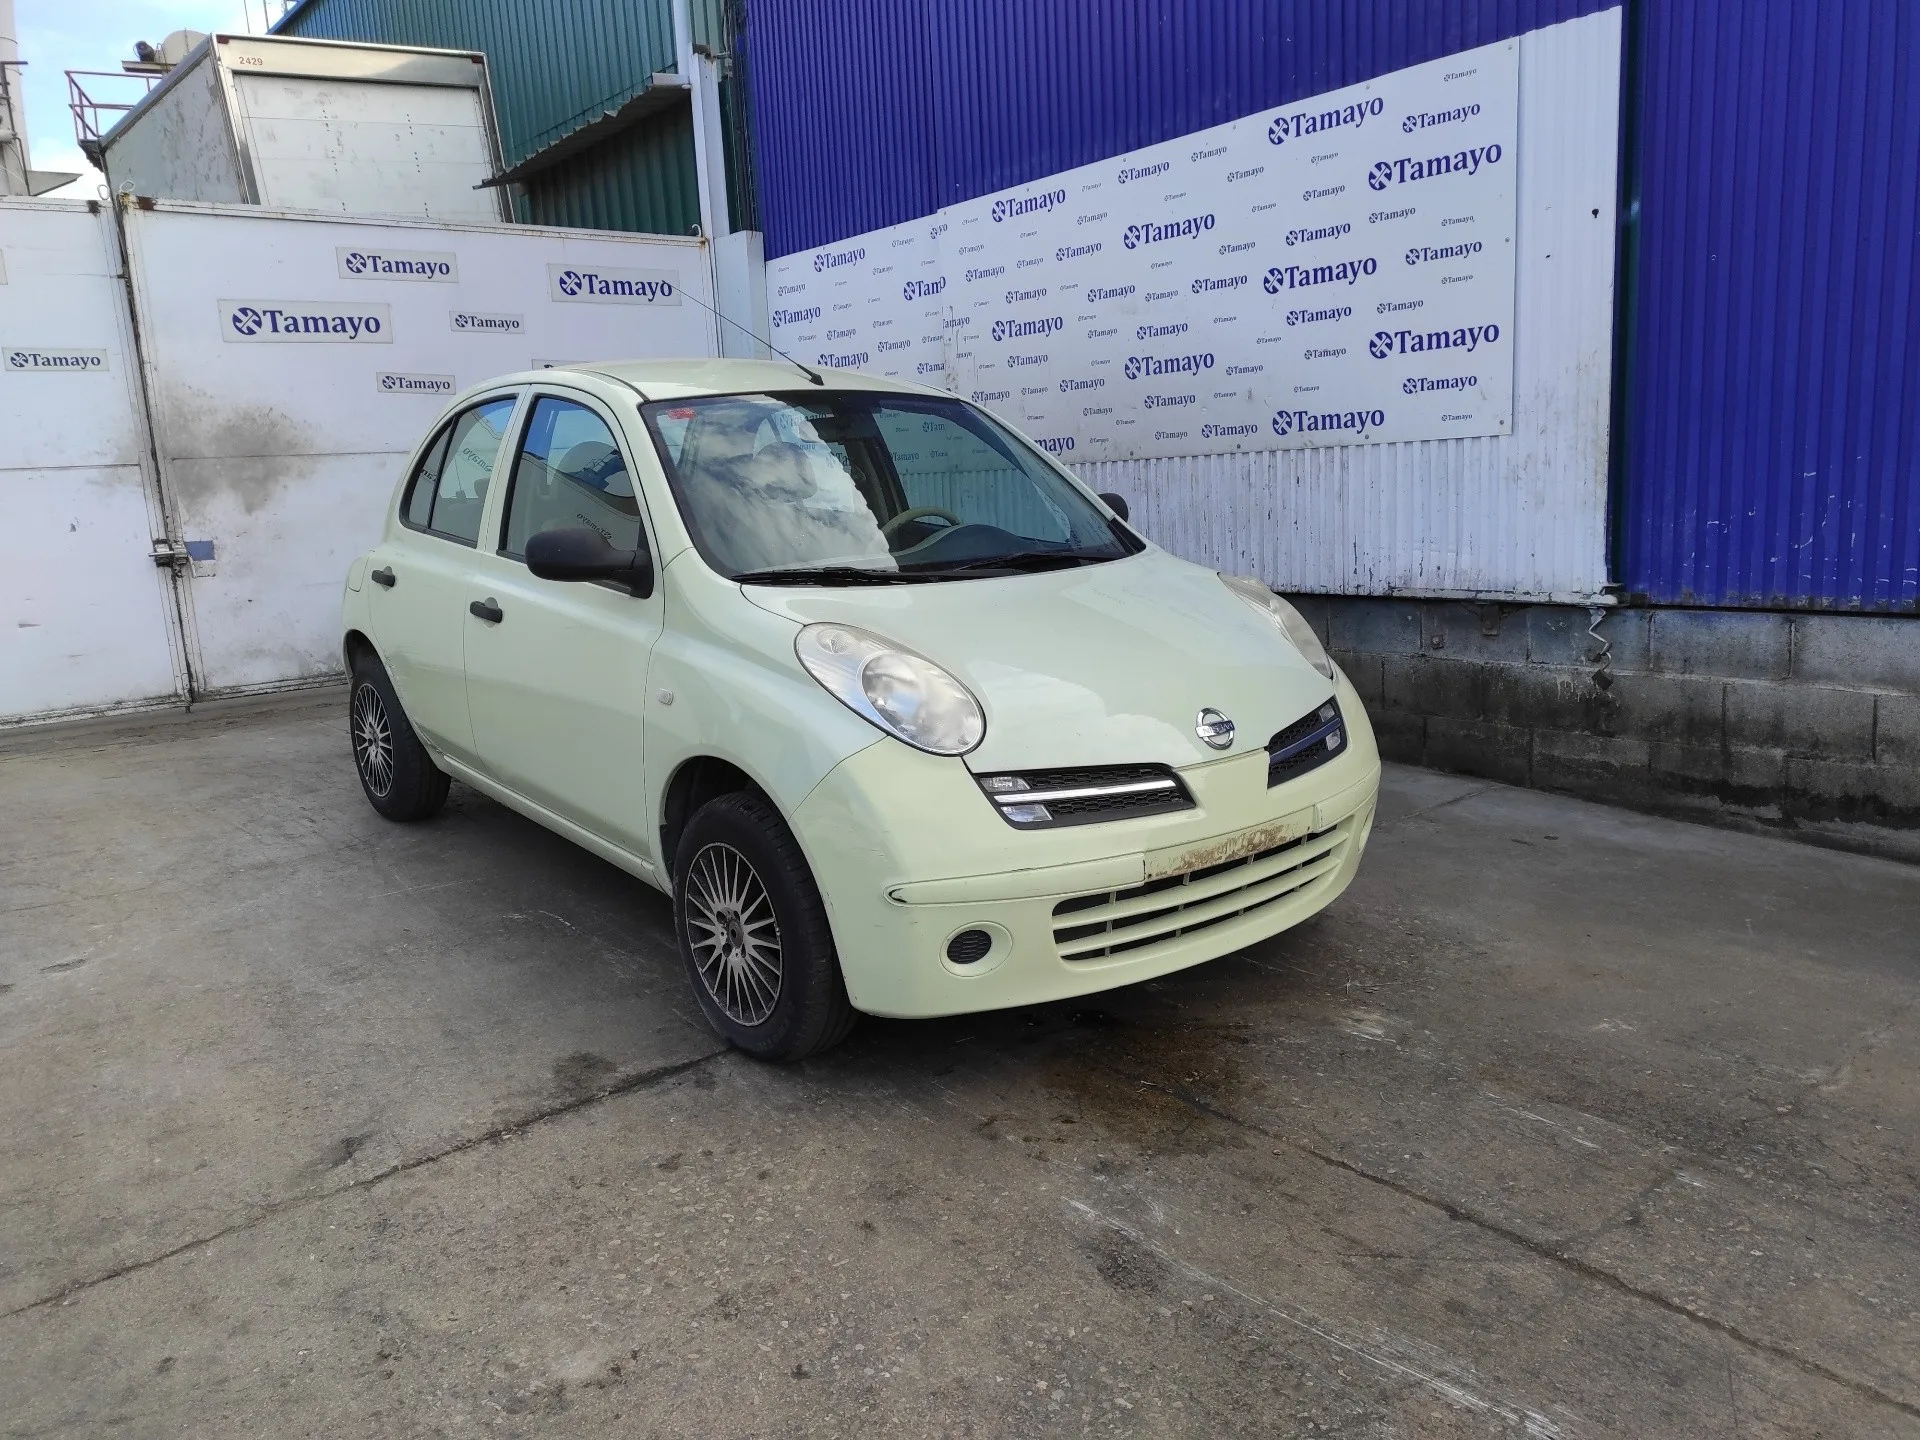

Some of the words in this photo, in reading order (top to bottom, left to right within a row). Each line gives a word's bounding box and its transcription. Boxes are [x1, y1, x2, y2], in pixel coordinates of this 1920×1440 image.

[239, 56, 263, 66] 2429
[1450, 68, 1477, 80] Tamayo
[1291, 97, 1384, 138] Tamayo
[1417, 103, 1481, 129] Tamayo
[1198, 146, 1227, 160] Tamayo
[1128, 161, 1170, 181] Tamayo
[1394, 144, 1502, 184] Tamayo
[1235, 165, 1264, 180] Tamayo
[1311, 184, 1345, 199] Tamayo
[1006, 189, 1066, 217] Tamayo
[1083, 212, 1108, 223] Tamayo
[1377, 207, 1416, 222] Tamayo
[1448, 215, 1474, 225] Tamayo
[1141, 213, 1215, 244] Tamayo
[1298, 222, 1351, 243] Tamayo
[1064, 242, 1102, 259] Tamayo
[1226, 241, 1256, 254] Tamayo
[1420, 241, 1482, 262] Tamayo
[824, 247, 866, 269] Tamayo
[1022, 257, 1044, 268] Tamayo
[367, 255, 451, 279] Tamayo
[973, 265, 1005, 280] Tamayo
[1285, 257, 1377, 289] Tamayo
[1202, 274, 1248, 291] Tamayo
[1448, 274, 1474, 284] Tamayo
[583, 273, 673, 302] Tamayo
[783, 283, 806, 295] Tamayo
[1014, 288, 1047, 302] Tamayo
[1097, 284, 1136, 300] Tamayo
[1151, 289, 1179, 301] Tamayo
[1386, 300, 1424, 313] Tamayo
[782, 306, 821, 324] Tamayo
[1299, 306, 1352, 323] Tamayo
[262, 310, 381, 340] Tamayo
[468, 315, 520, 331] Tamayo
[1006, 316, 1063, 338] Tamayo
[1147, 322, 1188, 339] Tamayo
[833, 328, 857, 340] Tamayo
[1093, 328, 1118, 338] Tamayo
[1395, 323, 1500, 354] Tamayo
[884, 339, 911, 351] Tamayo
[828, 352, 869, 369] Tamayo
[1015, 354, 1048, 366] Tamayo
[1313, 347, 1347, 359] Tamayo
[28, 353, 101, 370] Tamayo
[924, 363, 945, 374] Tama
[1142, 353, 1215, 376] Tamayo
[1232, 364, 1264, 376] Tamayo
[396, 376, 451, 392] Tamayo
[1027, 386, 1048, 395] Tamayo
[1068, 377, 1105, 391] Tamayo
[1417, 375, 1477, 393] Tamayo
[979, 390, 1010, 402] Tamayo
[1154, 394, 1196, 408] Tamayo
[1088, 407, 1113, 416] Tamayo
[1448, 413, 1473, 422] Tamayo
[1293, 409, 1384, 435] Tamayo
[1162, 431, 1188, 440] Tamayo
[1213, 424, 1258, 438] Tamayo
[1034, 436, 1075, 456] mayo
